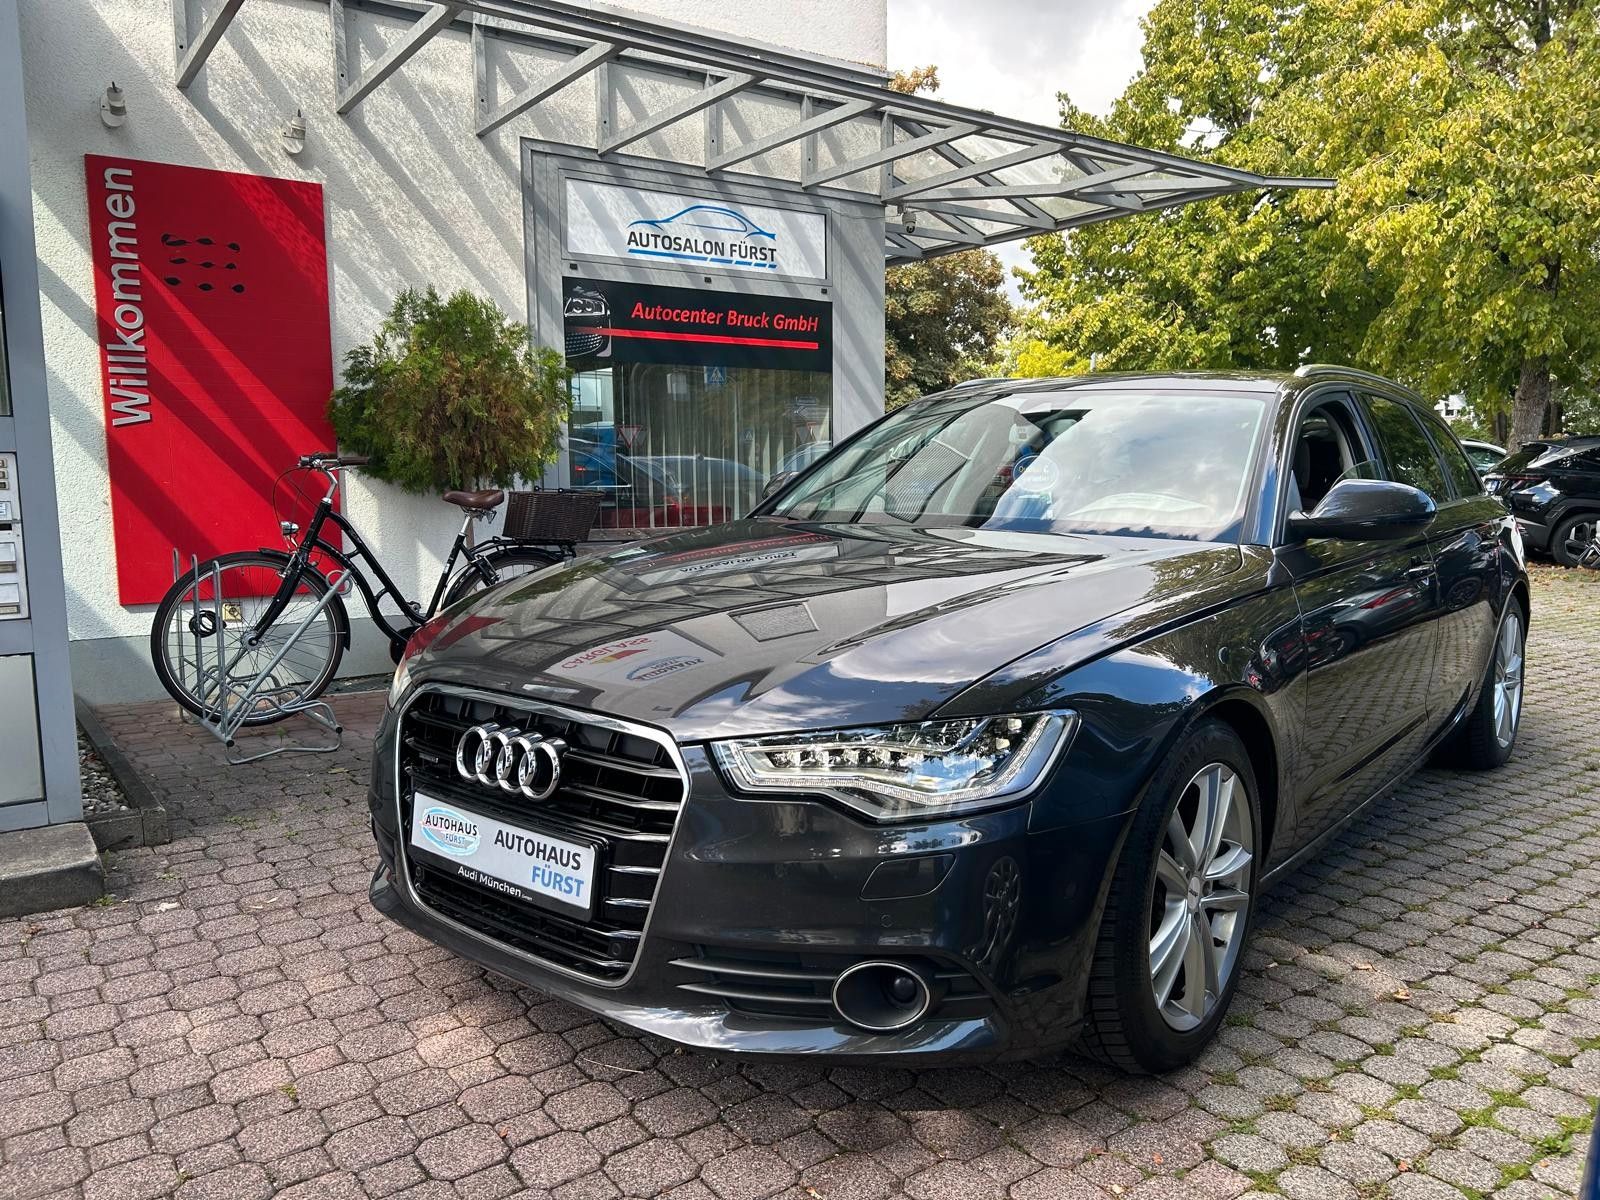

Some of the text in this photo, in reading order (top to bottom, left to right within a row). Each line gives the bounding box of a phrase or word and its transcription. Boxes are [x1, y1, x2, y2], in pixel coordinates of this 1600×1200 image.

[627, 231, 777, 262] AUTOSALON FÜRST
[105, 168, 152, 426] Willkommen
[632, 302, 819, 332] Autocenter Bruck GmbH
[425, 813, 478, 836] AUTOHAUS
[444, 832, 466, 845] FÜRST
[494, 828, 582, 871] AUTOHAUS
[457, 865, 478, 881] Audi
[479, 872, 522, 898] München
[531, 864, 584, 898] FÜRST
